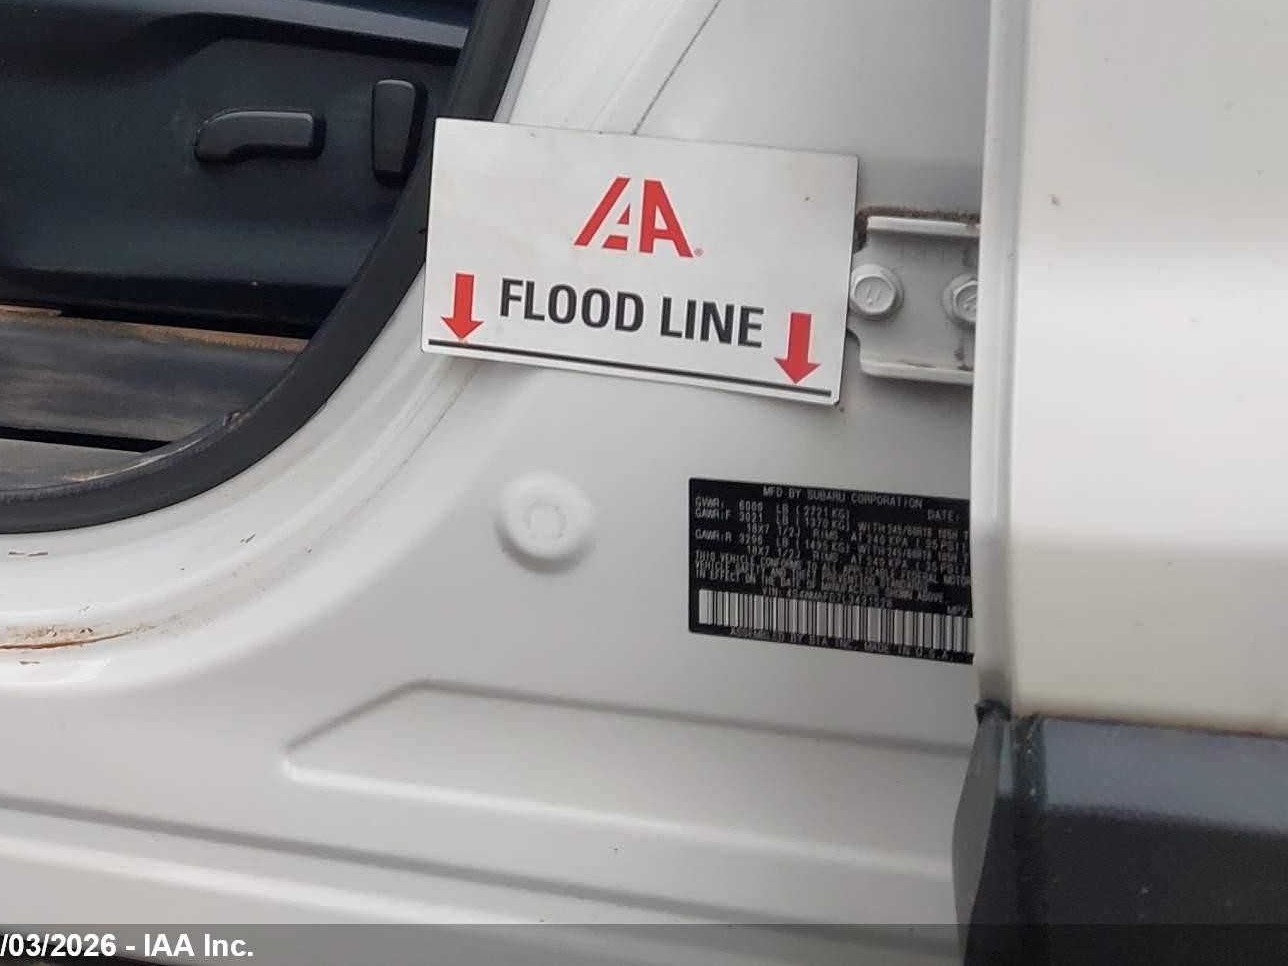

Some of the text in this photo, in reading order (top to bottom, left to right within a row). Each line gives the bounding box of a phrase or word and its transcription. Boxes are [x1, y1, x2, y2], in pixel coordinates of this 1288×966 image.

[500, 277, 764, 349] FLOOD LINE
[763, 486, 922, 507] MFD BY SUBARU CORPORATION
